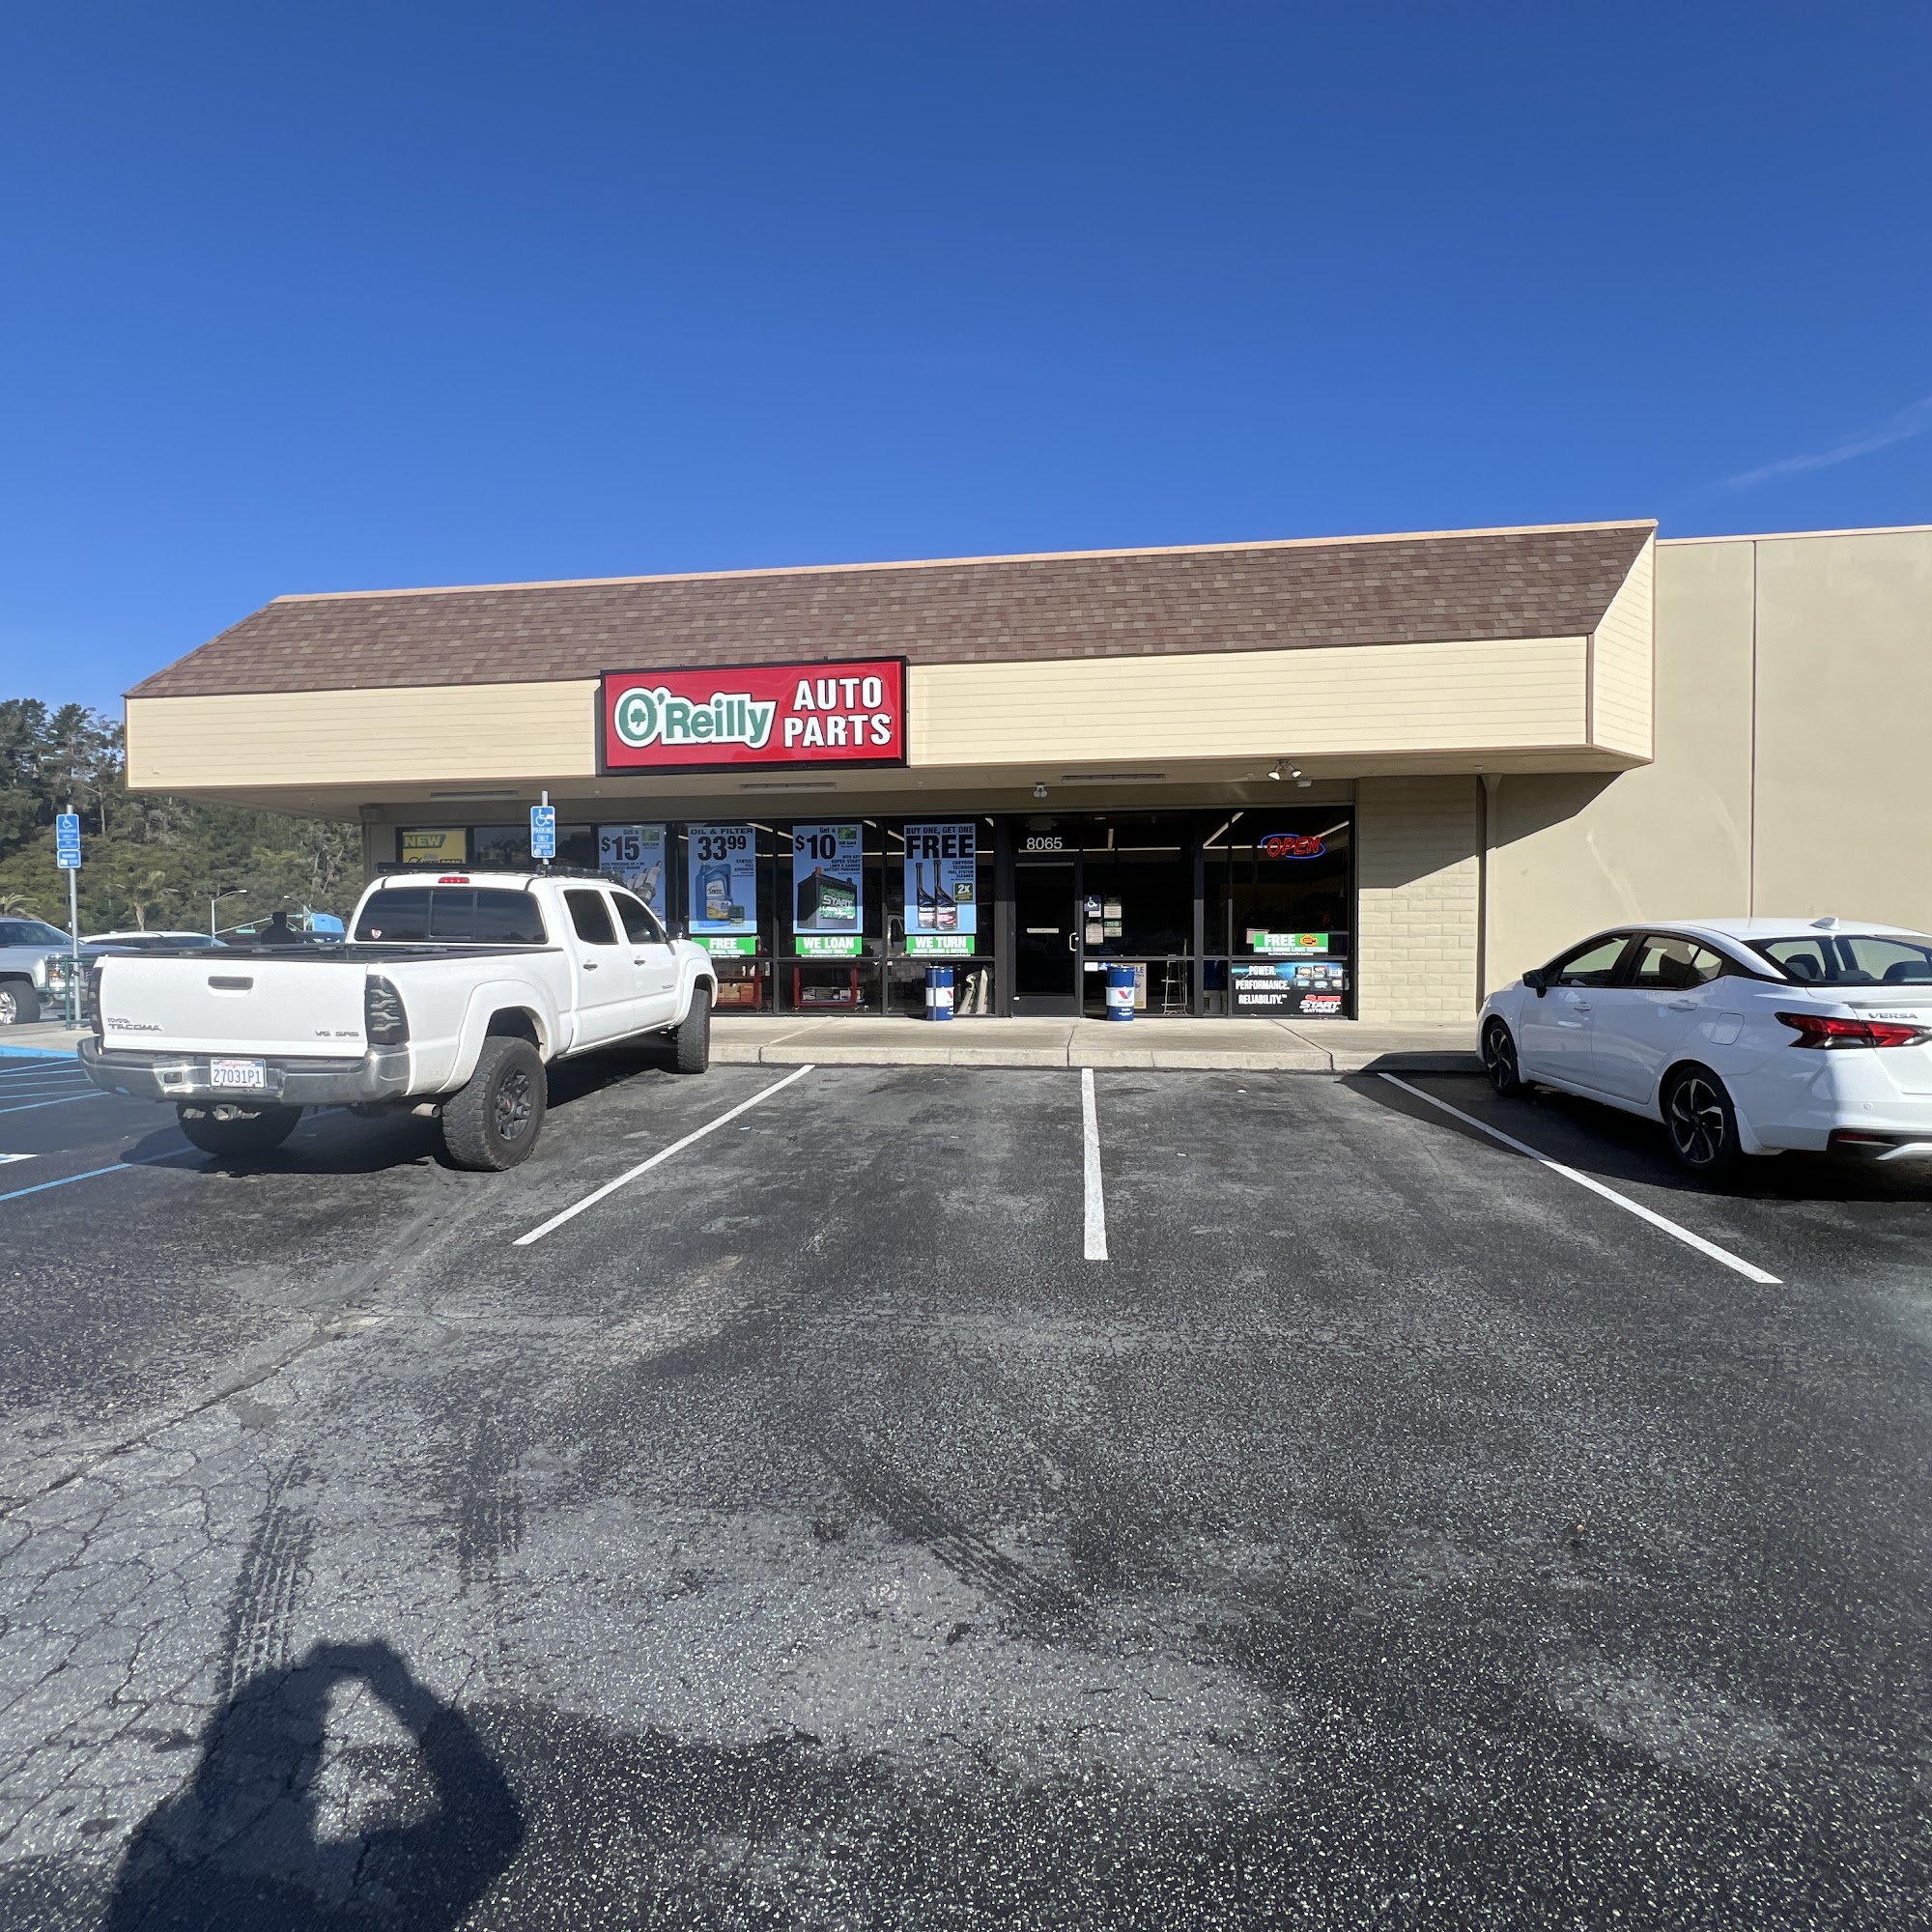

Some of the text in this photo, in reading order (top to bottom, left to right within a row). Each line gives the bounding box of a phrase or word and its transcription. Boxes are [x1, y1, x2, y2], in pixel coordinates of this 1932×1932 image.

[793, 676, 883, 711] AUTO
[615, 687, 776, 748] O'Reilly
[784, 713, 892, 748] PARTS
[404, 836, 440, 846] NEW
[906, 834, 974, 859] FREE
[1027, 838, 1063, 850] 8065
[1266, 836, 1321, 857] OPEN
[601, 836, 639, 861] $15
[795, 835, 836, 860] $10
[822, 895, 853, 907] START
[710, 938, 737, 949] FREE
[803, 937, 854, 949] WE LOAN
[915, 936, 966, 948] WE TURN
[1264, 934, 1295, 947] FREE
[1249, 966, 1276, 976] POWER.
[1236, 980, 1290, 990] PERFORMANCE.
[1299, 1000, 1342, 1009] START
[1304, 994, 1341, 1003] SUPER
[213, 1068, 262, 1084] 27031P1
